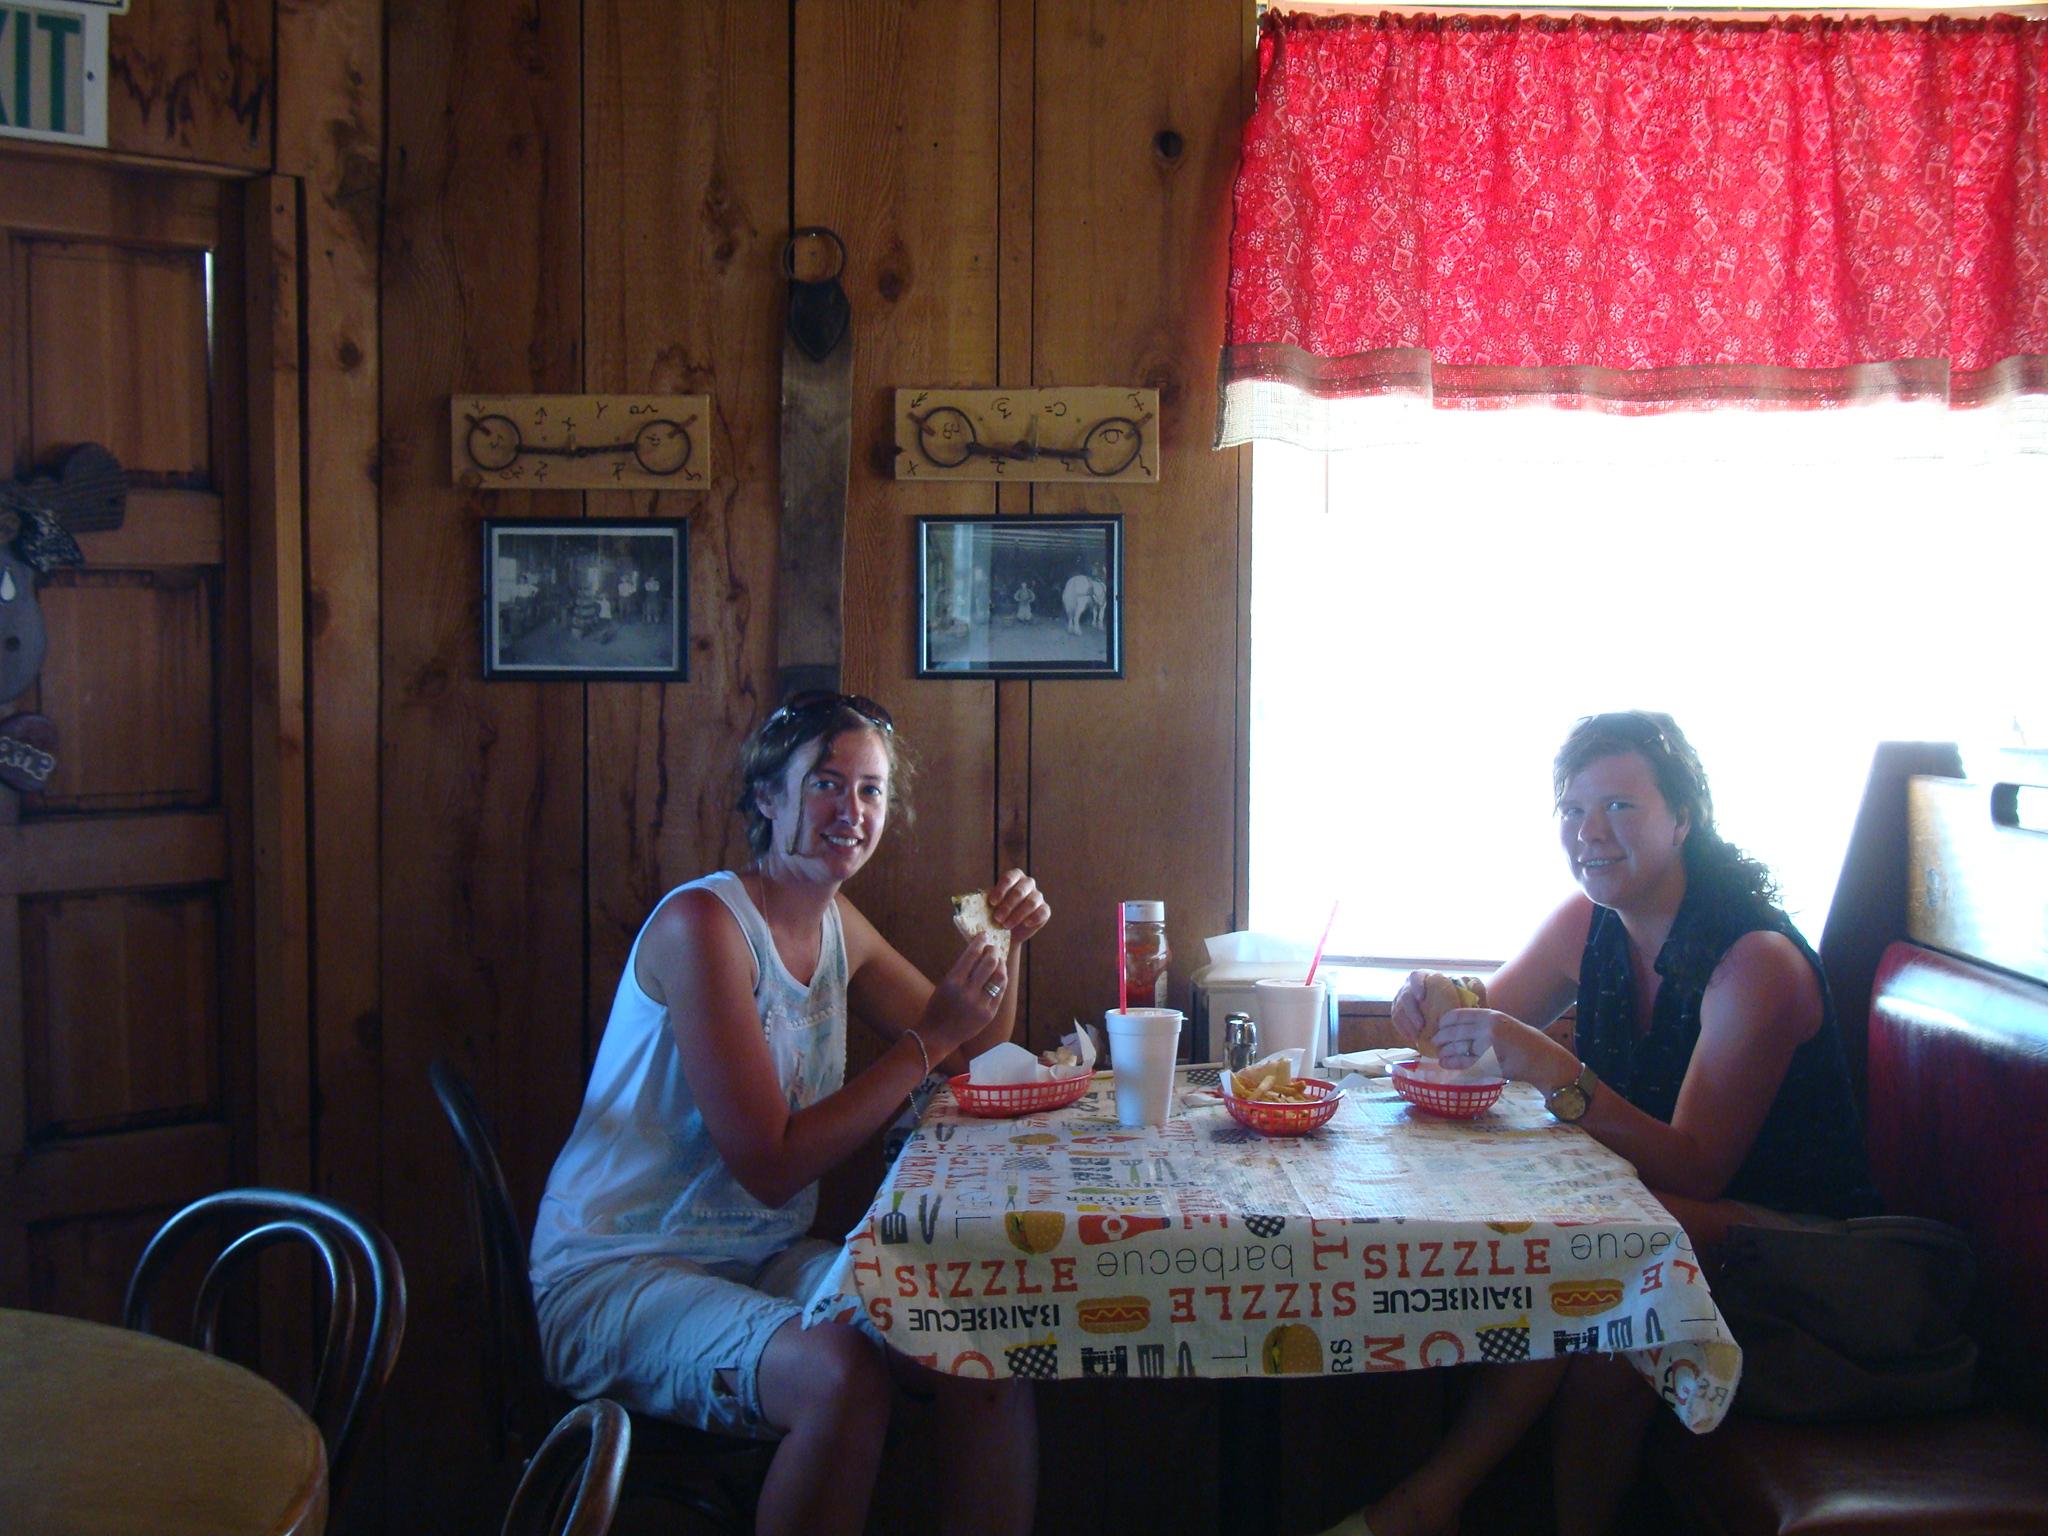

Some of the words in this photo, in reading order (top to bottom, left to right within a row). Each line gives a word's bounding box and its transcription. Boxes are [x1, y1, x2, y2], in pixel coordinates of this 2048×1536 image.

[0, 9, 82, 133] IT
[896, 1257, 1079, 1298] SIZZLE
[1097, 1244, 1294, 1280] barbecue
[1363, 1239, 1552, 1280] SIZZLE
[909, 1304, 1061, 1332] BARBECUE
[1169, 1281, 1357, 1323] SIZZLE
[1374, 1286, 1533, 1314] BARBECUE
